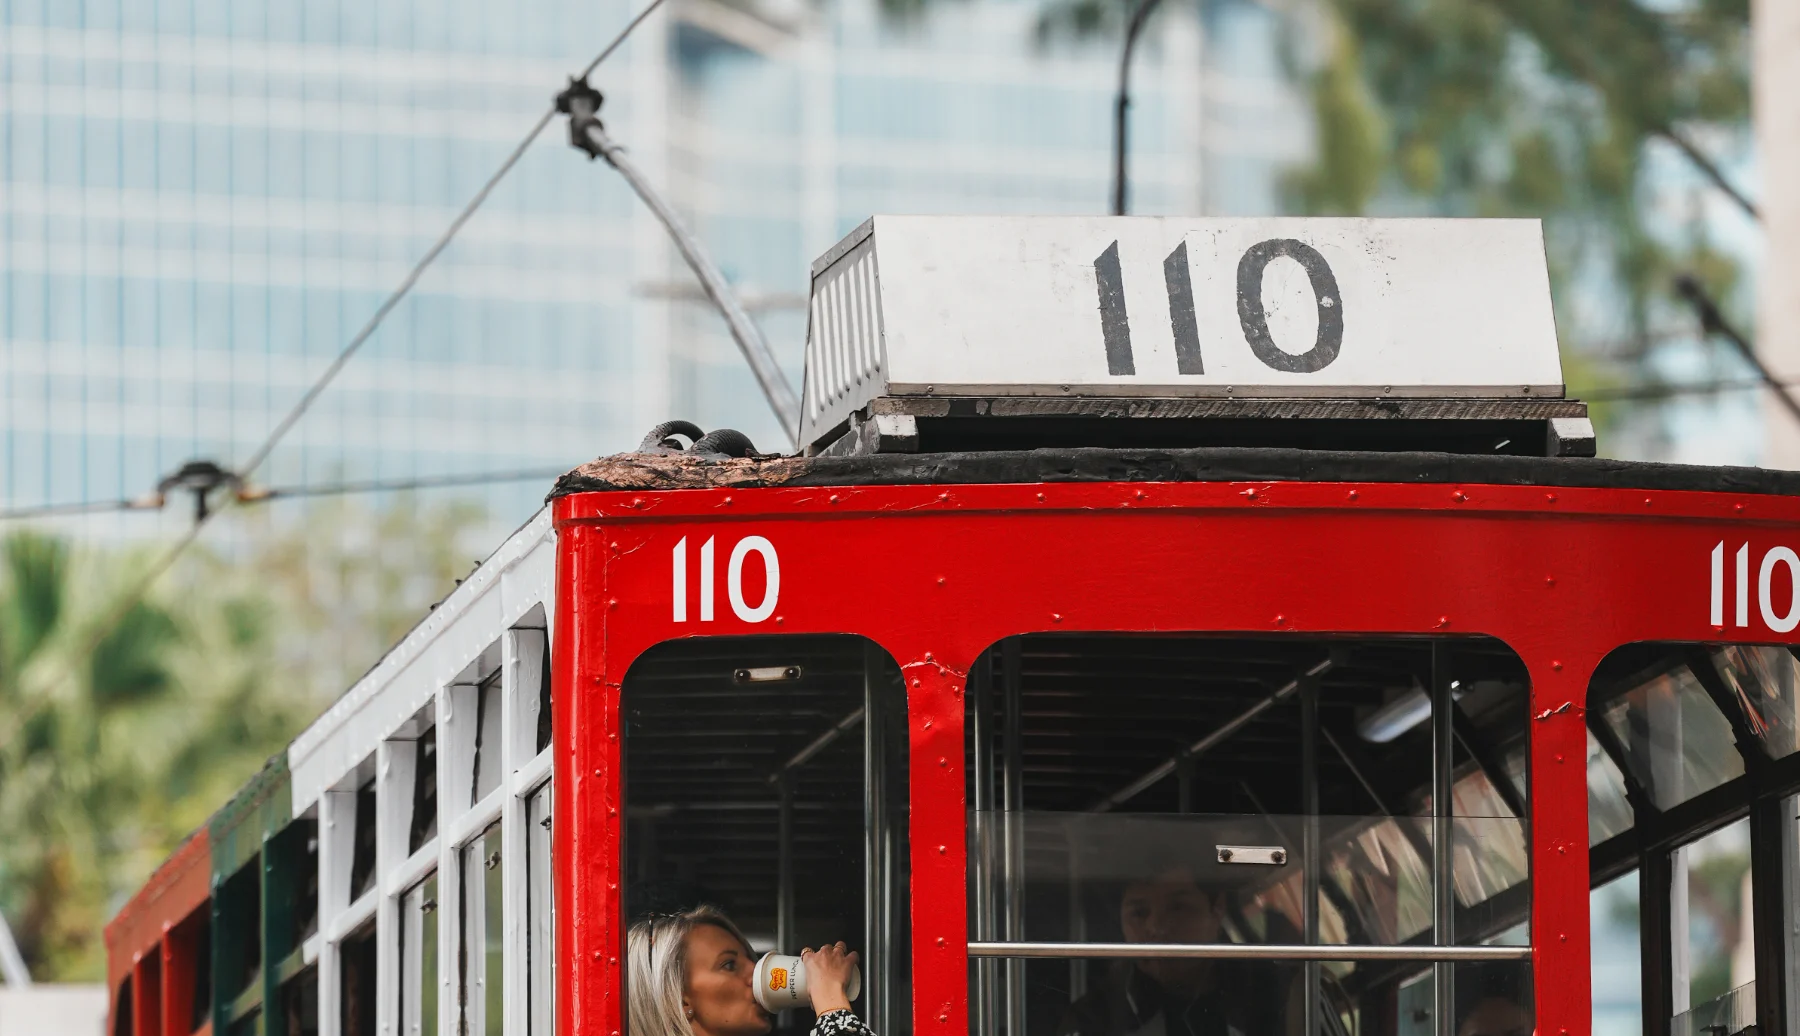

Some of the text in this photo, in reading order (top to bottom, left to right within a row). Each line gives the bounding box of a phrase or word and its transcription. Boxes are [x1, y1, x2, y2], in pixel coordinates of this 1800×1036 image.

[1093, 238, 1344, 376] 110
[673, 535, 781, 622] 110
[1710, 540, 1800, 633] 110
